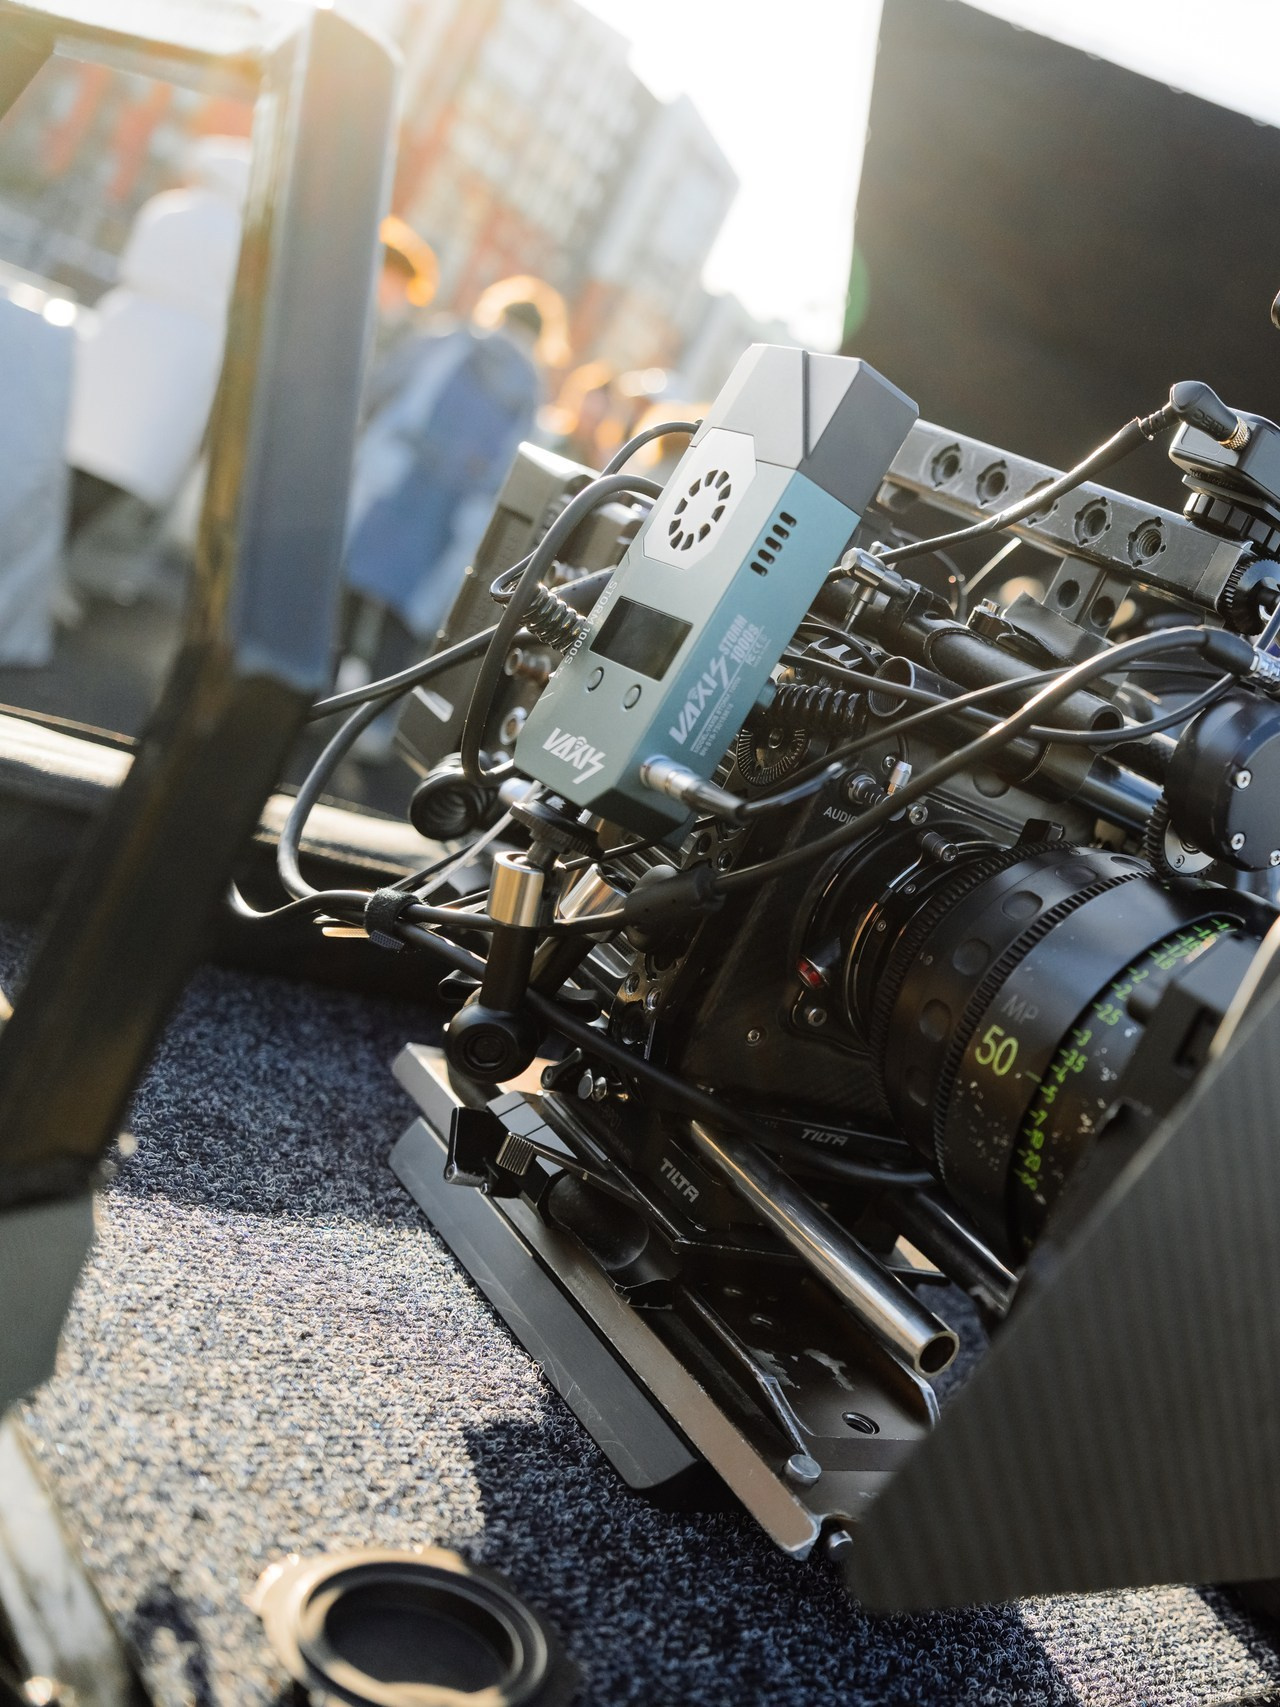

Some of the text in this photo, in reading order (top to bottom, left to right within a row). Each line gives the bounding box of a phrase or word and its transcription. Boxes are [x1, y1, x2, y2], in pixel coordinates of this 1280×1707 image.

[586, 580, 618, 627] STORM
[564, 626, 591, 665] 1000S
[718, 614, 749, 656] STORM
[668, 655, 730, 745] VAXIS
[542, 727, 607, 785] VAXIS
[975, 1024, 1019, 1076] 50
[801, 1128, 849, 1147] TILTA
[660, 1157, 700, 1203] TILTA
